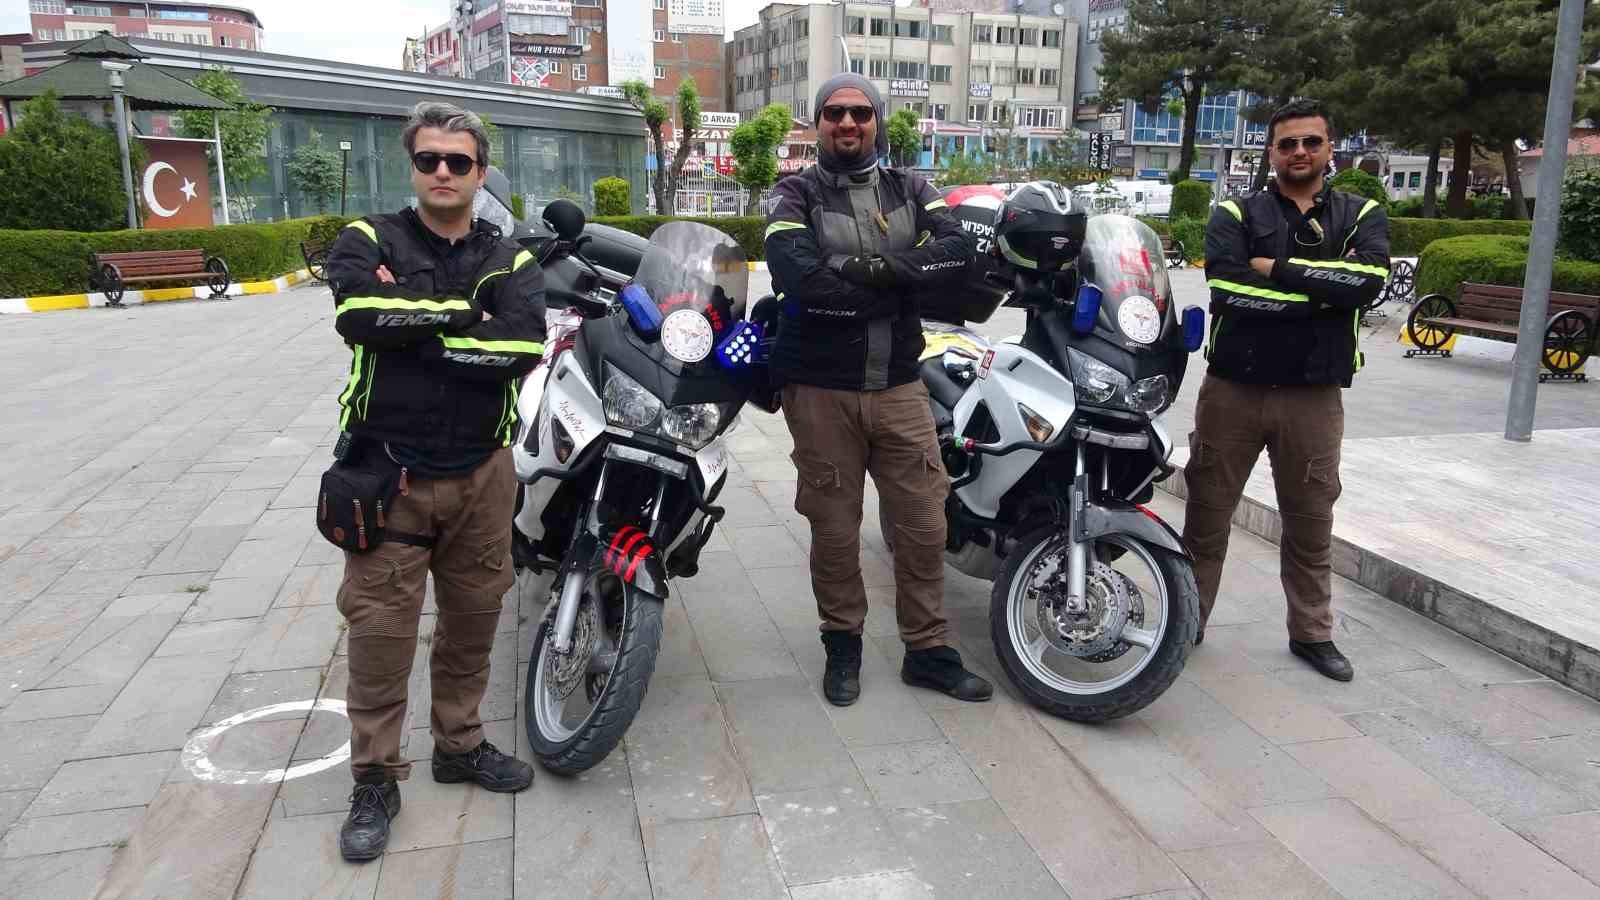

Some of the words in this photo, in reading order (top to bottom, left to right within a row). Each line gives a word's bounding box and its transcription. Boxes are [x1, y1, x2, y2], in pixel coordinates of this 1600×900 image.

[528, 45, 542, 53] NUR
[544, 47, 567, 55] PERDE
[711, 114, 737, 124] ARVAS
[921, 260, 967, 271] VENOM
[1303, 268, 1368, 287] VENOM
[1226, 295, 1288, 312] VENOM
[807, 307, 857, 317] VENOM
[441, 350, 517, 367] VENOM
